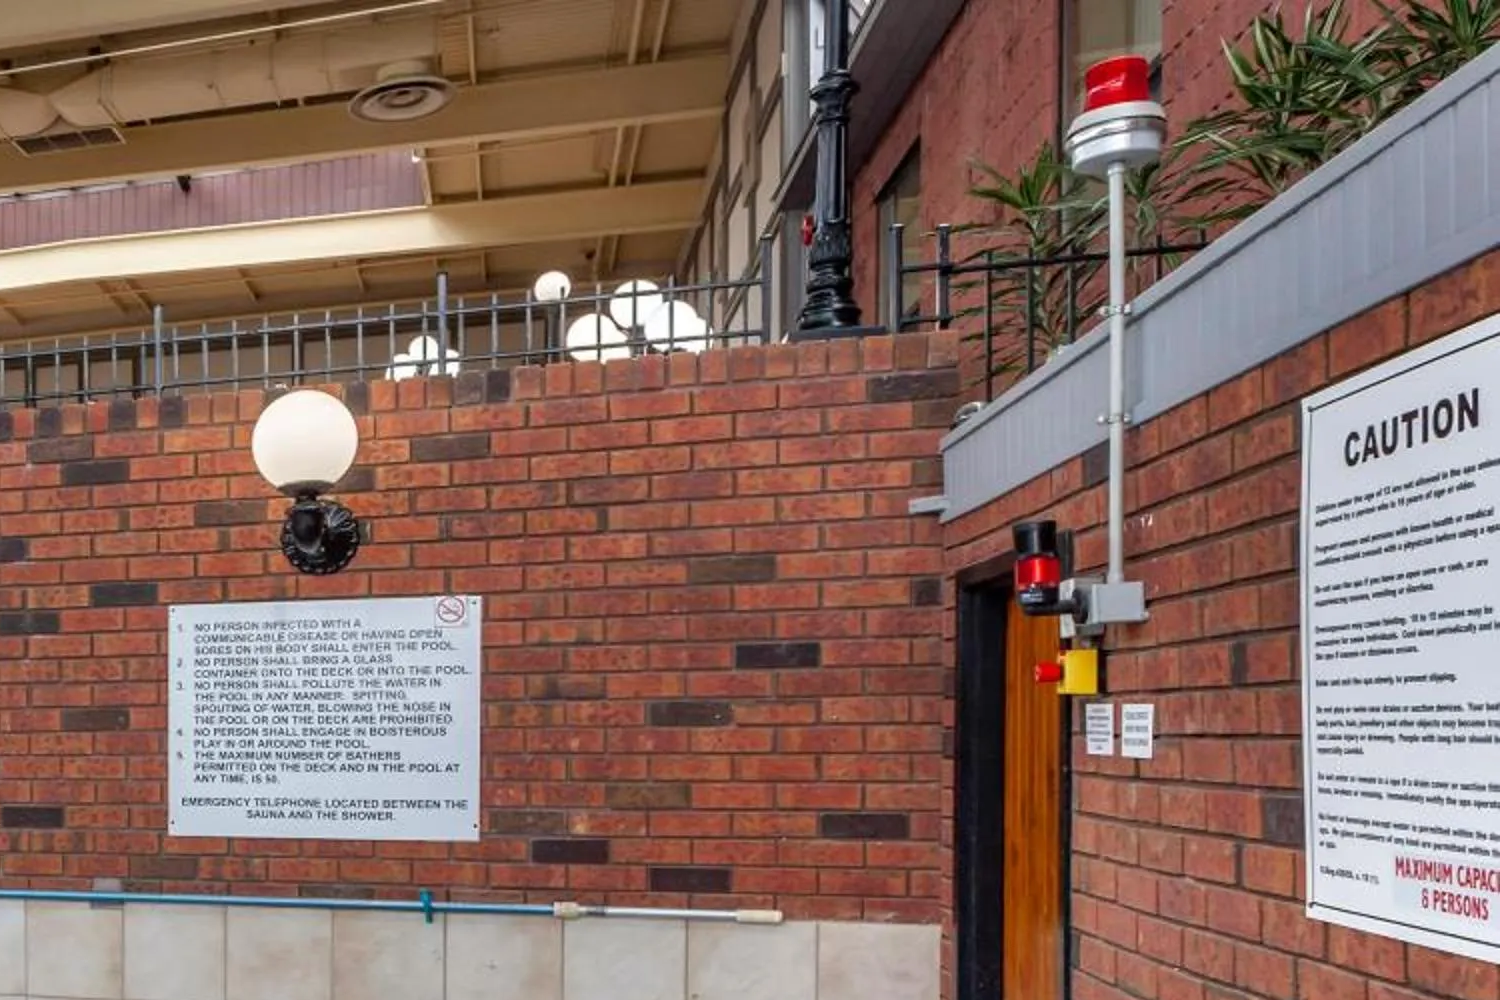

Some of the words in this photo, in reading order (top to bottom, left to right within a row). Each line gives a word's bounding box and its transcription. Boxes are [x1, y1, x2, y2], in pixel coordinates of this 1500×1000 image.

[1344, 386, 1480, 467] CAUTION
[194, 622, 210, 632] NO
[213, 621, 258, 631] PERSON
[262, 619, 318, 630] INFECTED
[321, 618, 350, 629] WITH
[353, 618, 361, 628] A
[194, 632, 285, 644] COMMUNICABLE
[287, 630, 337, 642] DISEASE
[340, 630, 358, 641] OR
[361, 629, 405, 640] HAVING
[409, 628, 442, 639] OPEN
[194, 645, 232, 655] SORES
[234, 644, 251, 655] ON
[275, 643, 308, 654] BODY
[310, 642, 349, 653] SHALL
[351, 641, 391, 652] ENTER
[395, 640, 418, 651] THE
[193, 657, 210, 667] NO
[213, 656, 258, 667] PERSON
[261, 655, 298, 666] SHALL
[302, 654, 338, 665] BRING
[341, 654, 350, 664] A
[353, 653, 392, 664] GLASS
[193, 667, 258, 679] CONTAINER
[260, 667, 292, 678] ONTO
[295, 666, 319, 677] THE
[321, 666, 354, 677] DECK
[354, 665, 375, 676] OR
[377, 665, 405, 676] INTO
[407, 664, 432, 675] THE
[193, 680, 211, 690] NO
[213, 679, 258, 690] PERSON
[261, 679, 299, 689] SHALL
[301, 678, 357, 689] POLLUTE
[357, 677, 382, 688] THE
[384, 677, 427, 688] WATER
[429, 676, 441, 687] IN
[194, 692, 213, 702] THE
[219, 691, 246, 701] POOL
[252, 691, 262, 701] IN
[267, 691, 287, 701] ANY
[194, 703, 250, 714] SPOUTING
[253, 703, 269, 713] OF
[317, 702, 372, 713] BLOWING
[376, 701, 398, 712] THE
[403, 701, 436, 712] NOSE
[439, 701, 450, 712] IN
[193, 715, 215, 725] THE
[218, 715, 248, 725] POOL
[251, 714, 268, 725] OR
[271, 714, 288, 725] ON
[291, 714, 314, 725] THE
[317, 714, 348, 725] DECK
[351, 714, 376, 724] ARE
[193, 727, 210, 737] NO
[213, 726, 258, 737] PERSON
[261, 726, 297, 737] SHALL
[301, 726, 350, 736] ENGAGE
[354, 726, 366, 736] IN
[369, 725, 446, 736] BOISTEROUS
[193, 739, 222, 749] PLAY
[223, 739, 236, 749] IN
[237, 739, 255, 749] OR
[256, 738, 306, 748] AROUND
[309, 738, 333, 748] THE
[194, 750, 215, 760] THE
[218, 750, 272, 760] MAXIMUM
[275, 750, 324, 760] NUMBER
[326, 750, 342, 760] OF
[345, 750, 400, 760] BATHERS
[193, 761, 257, 772] PERMITTED
[259, 761, 276, 772] ON
[279, 762, 300, 772] THE
[304, 762, 336, 772] DECK
[339, 762, 364, 772] AND
[367, 762, 378, 773] IN
[381, 762, 405, 773] THE
[408, 762, 442, 773] POOL
[444, 762, 459, 773] AT
[193, 774, 216, 782] ANY
[251, 774, 263, 782] IS
[181, 796, 250, 807] EMERGENCY
[252, 797, 321, 808] TELEPHONE
[324, 798, 379, 809] LOCATED
[381, 798, 440, 809] BETWEEN
[444, 799, 467, 810] THE
[245, 809, 286, 819] SAUNA
[287, 810, 313, 819] AND
[314, 810, 339, 820] THE
[1395, 855, 1453, 885] MAXIMUM
[1421, 887, 1430, 909] 6
[1433, 889, 1490, 921] PERSONS
